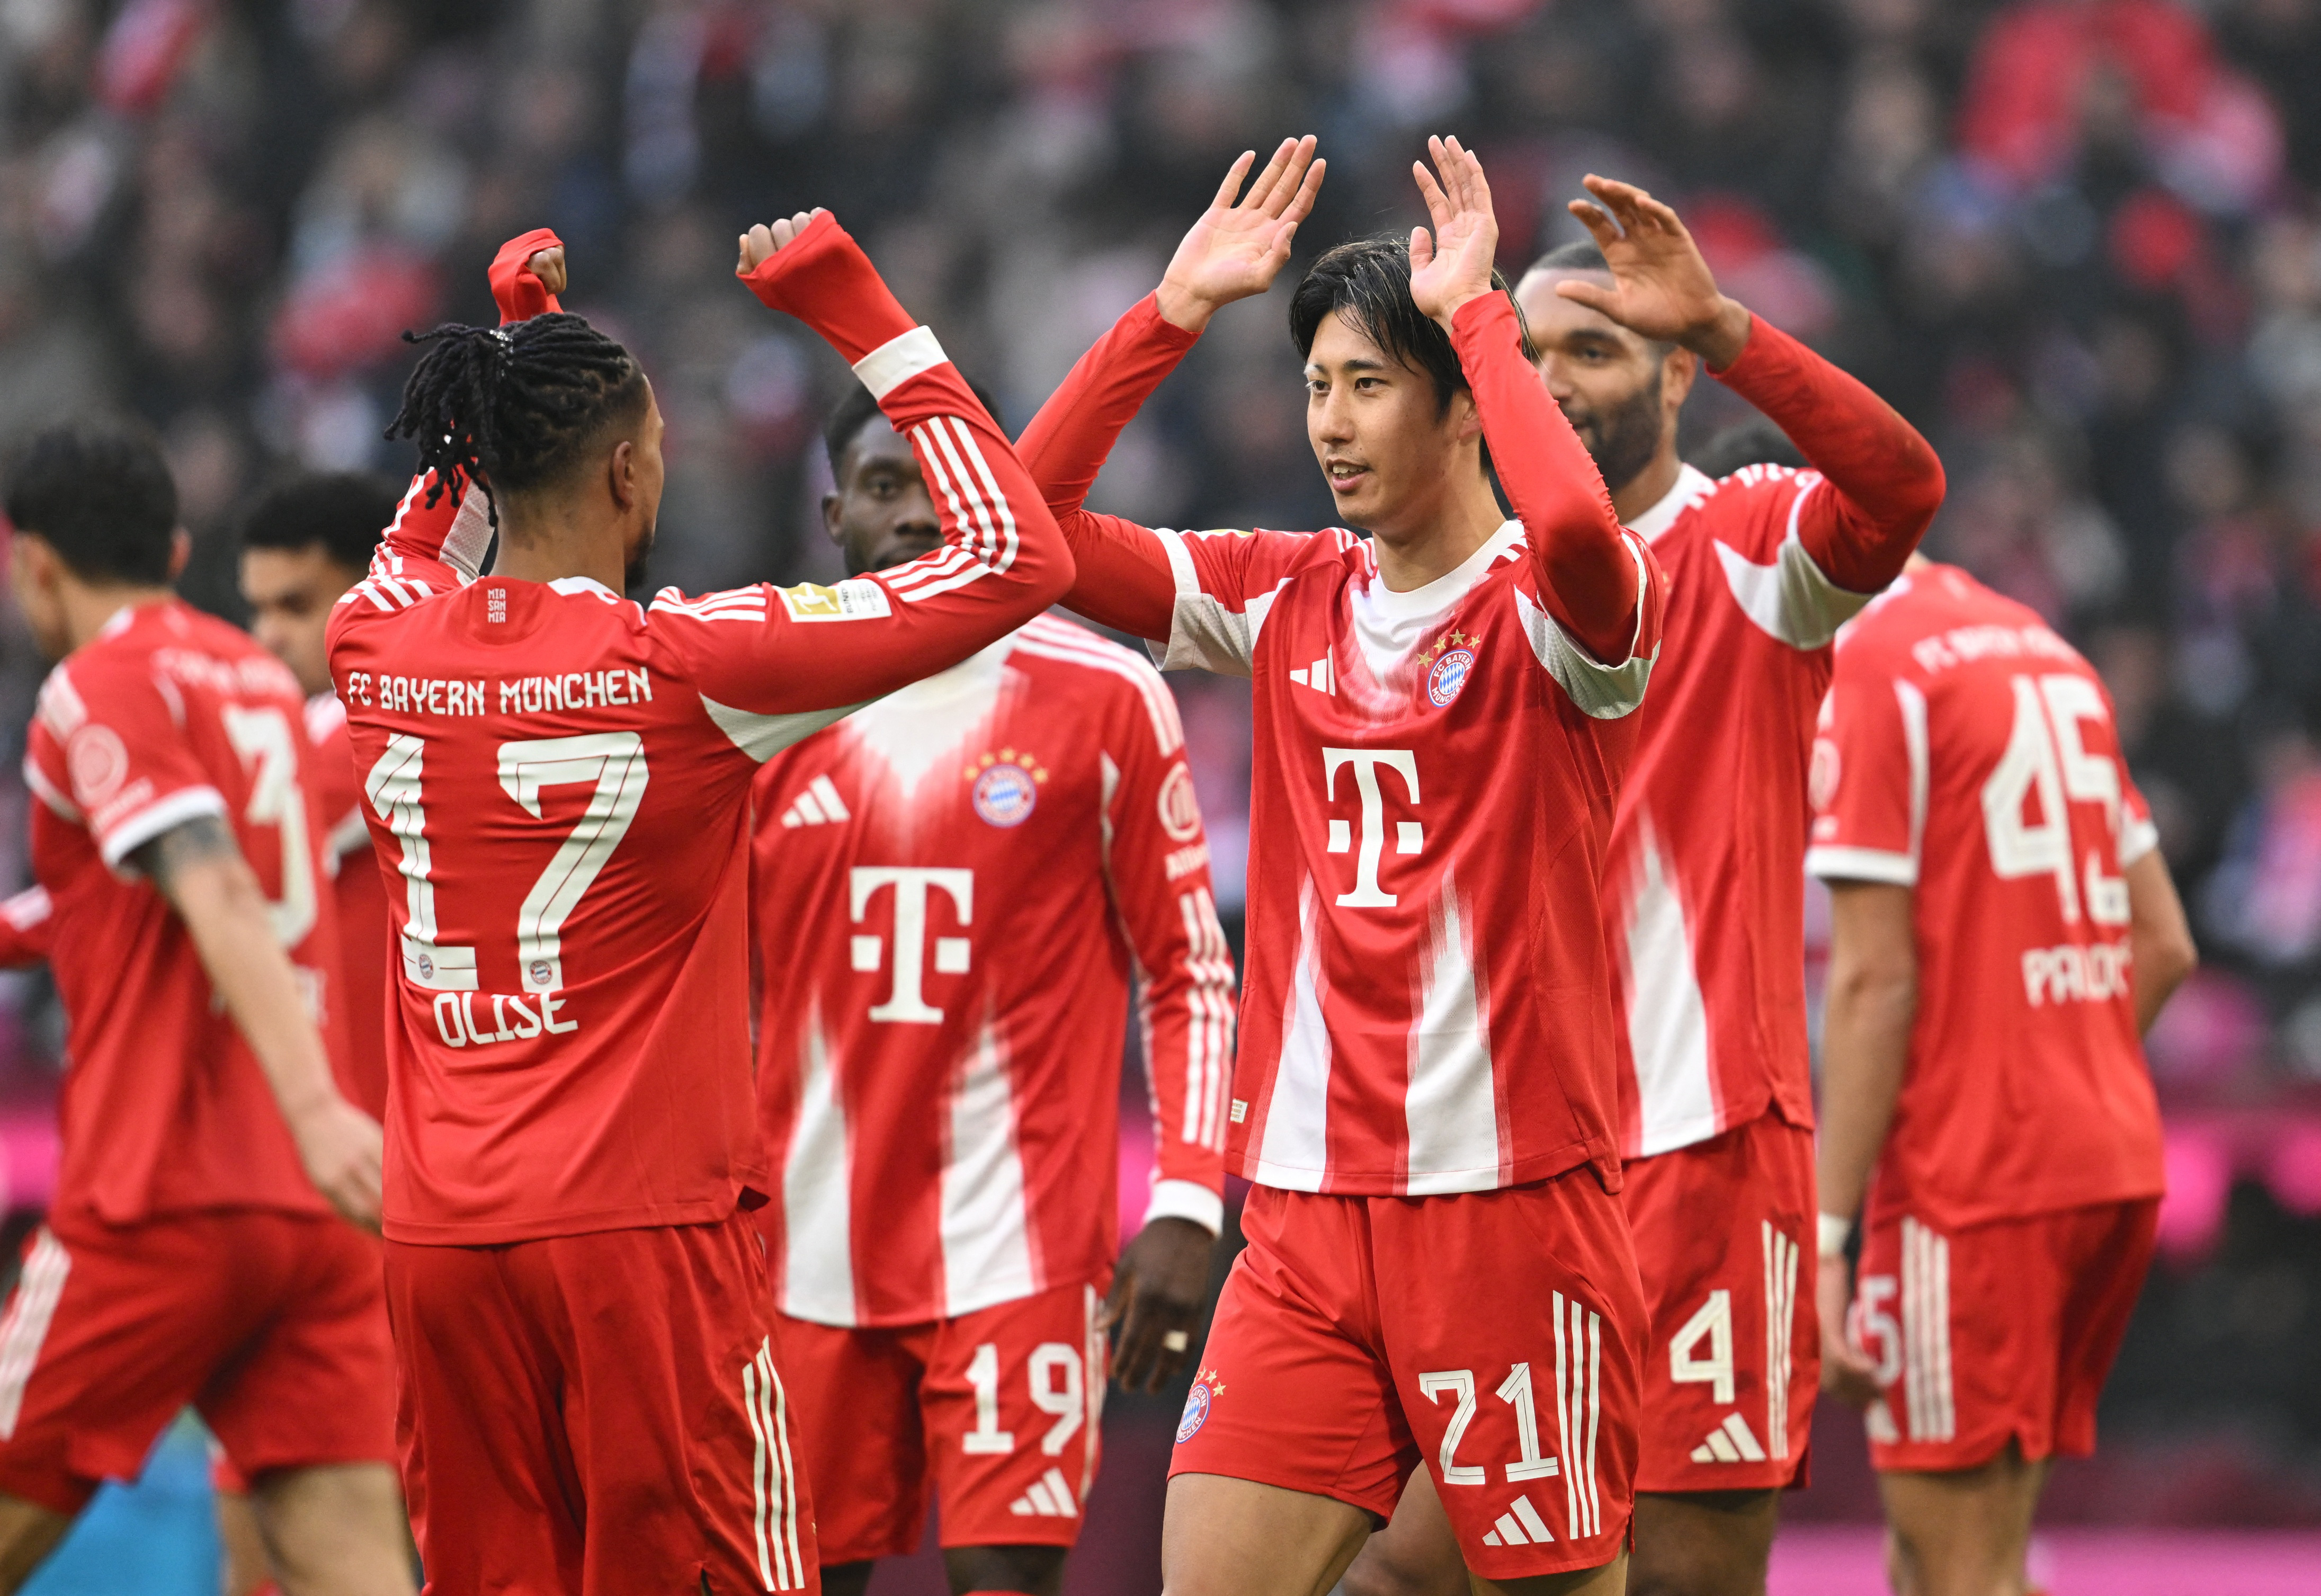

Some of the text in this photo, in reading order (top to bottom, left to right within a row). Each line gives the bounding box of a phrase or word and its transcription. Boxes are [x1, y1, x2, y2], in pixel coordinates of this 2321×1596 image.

[488, 588, 506, 599] MIA
[488, 600, 506, 611] SAN
[488, 611, 506, 623] MIA
[348, 671, 372, 706] FC
[380, 675, 485, 716] BAYERN
[499, 666, 653, 714] MÜNCHEN
[1433, 654, 1472, 677] FC BAYERN
[1322, 747, 1424, 907] T
[1981, 673, 2132, 926] 45
[364, 732, 649, 991] 17
[850, 866, 973, 1024] T
[433, 992, 578, 1048] OLISE
[962, 1342, 1084, 1456] 19
[1669, 1289, 1735, 1404] 4
[1418, 1362, 1559, 1485] 21
